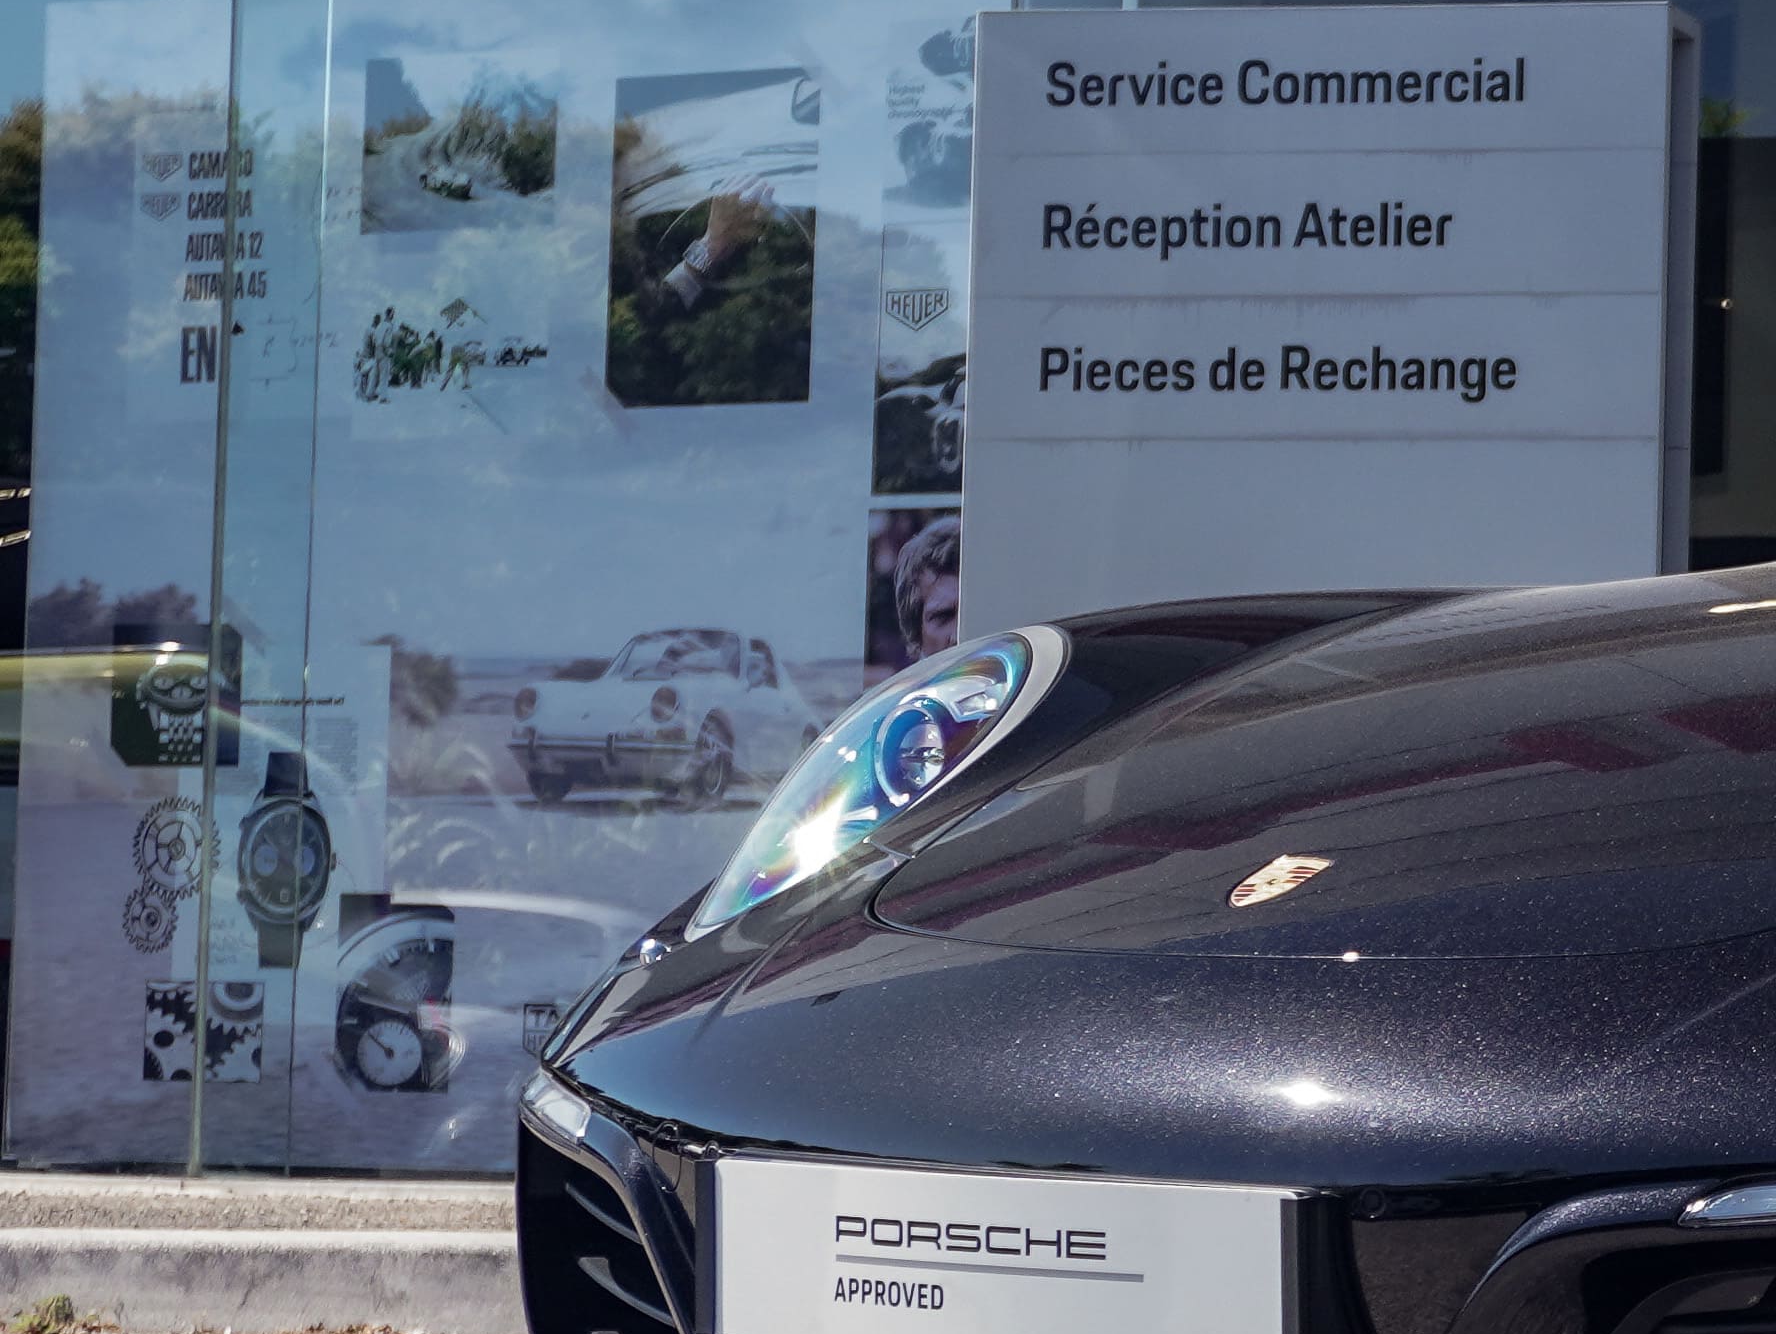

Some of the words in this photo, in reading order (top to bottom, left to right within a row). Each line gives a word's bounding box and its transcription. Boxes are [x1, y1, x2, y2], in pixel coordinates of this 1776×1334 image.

[1046, 61, 1223, 106] Service
[1237, 57, 1526, 105] Commercial
[187, 190, 252, 220] CARRRA
[184, 232, 245, 262] AUTAVA
[248, 231, 264, 259] 12
[1042, 203, 1281, 260] Réception
[1294, 201, 1453, 248] Atelier
[182, 272, 244, 301] AUTAVA
[246, 271, 268, 298] 45
[890, 292, 945, 324] HEUER
[1038, 346, 1195, 392] Pieces
[1208, 346, 1265, 391] de
[1279, 344, 1518, 403] Rechange
[835, 1215, 1107, 1261] PORSCHE
[833, 1276, 945, 1310] APPROVED
